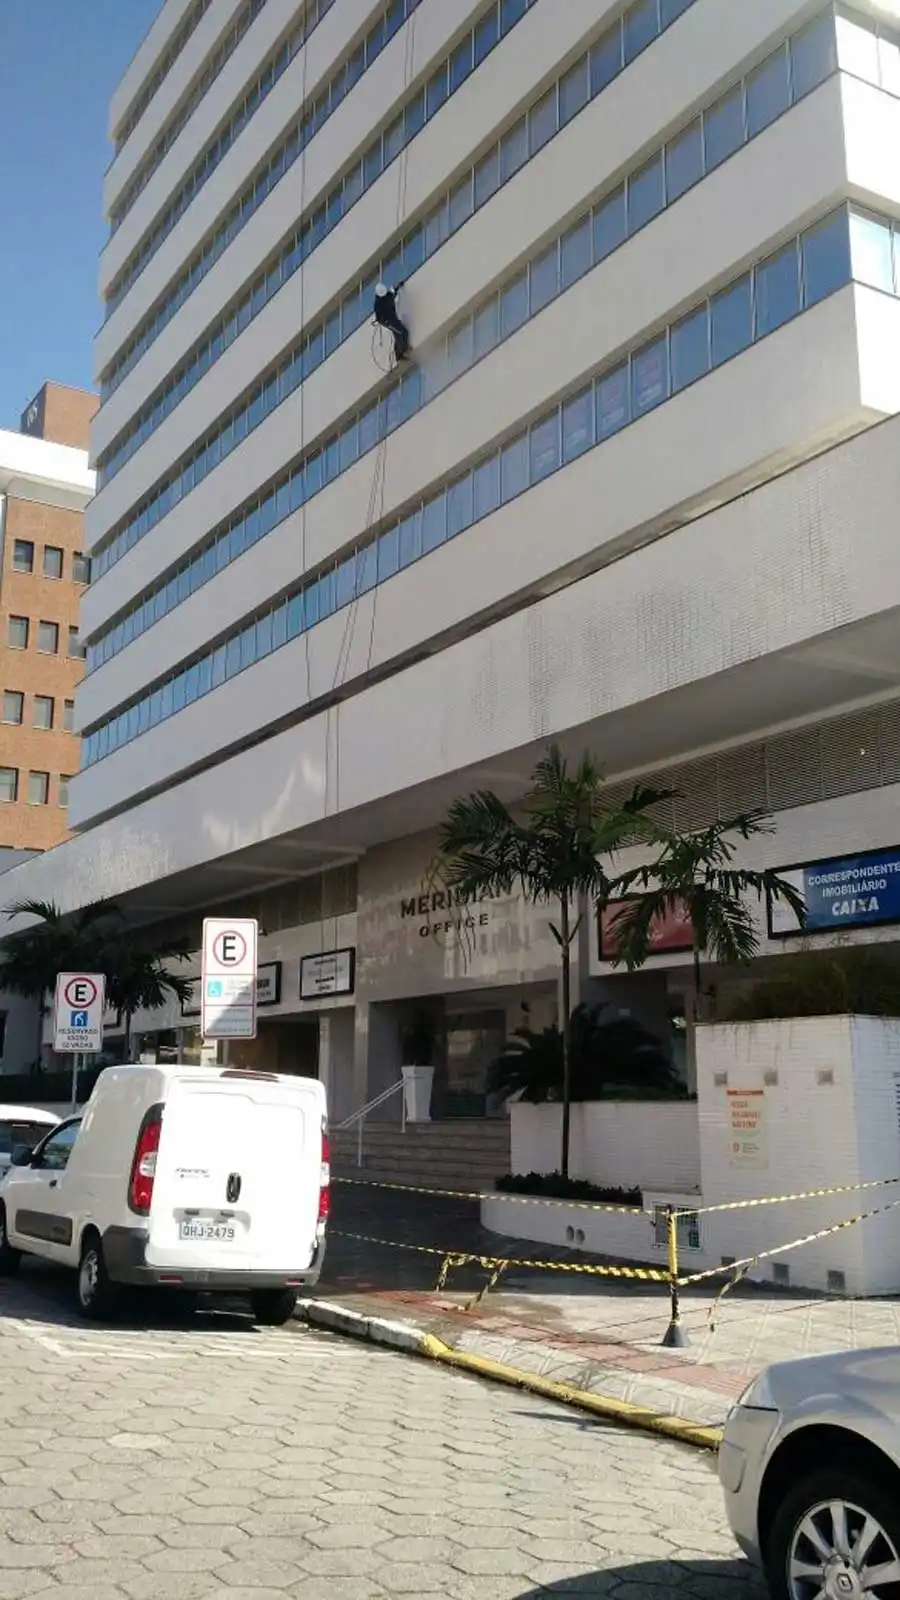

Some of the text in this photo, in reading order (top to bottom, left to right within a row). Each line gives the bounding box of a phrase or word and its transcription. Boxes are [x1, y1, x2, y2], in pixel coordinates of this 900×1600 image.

[808, 861, 900, 886] CORRESPONDENTE
[822, 879, 887, 898] IMOBILIÁRIO
[831, 896, 880, 916] CAIXA
[419, 913, 488, 938] OFFICE
[222, 935, 236, 961] E
[75, 983, 87, 1002] E
